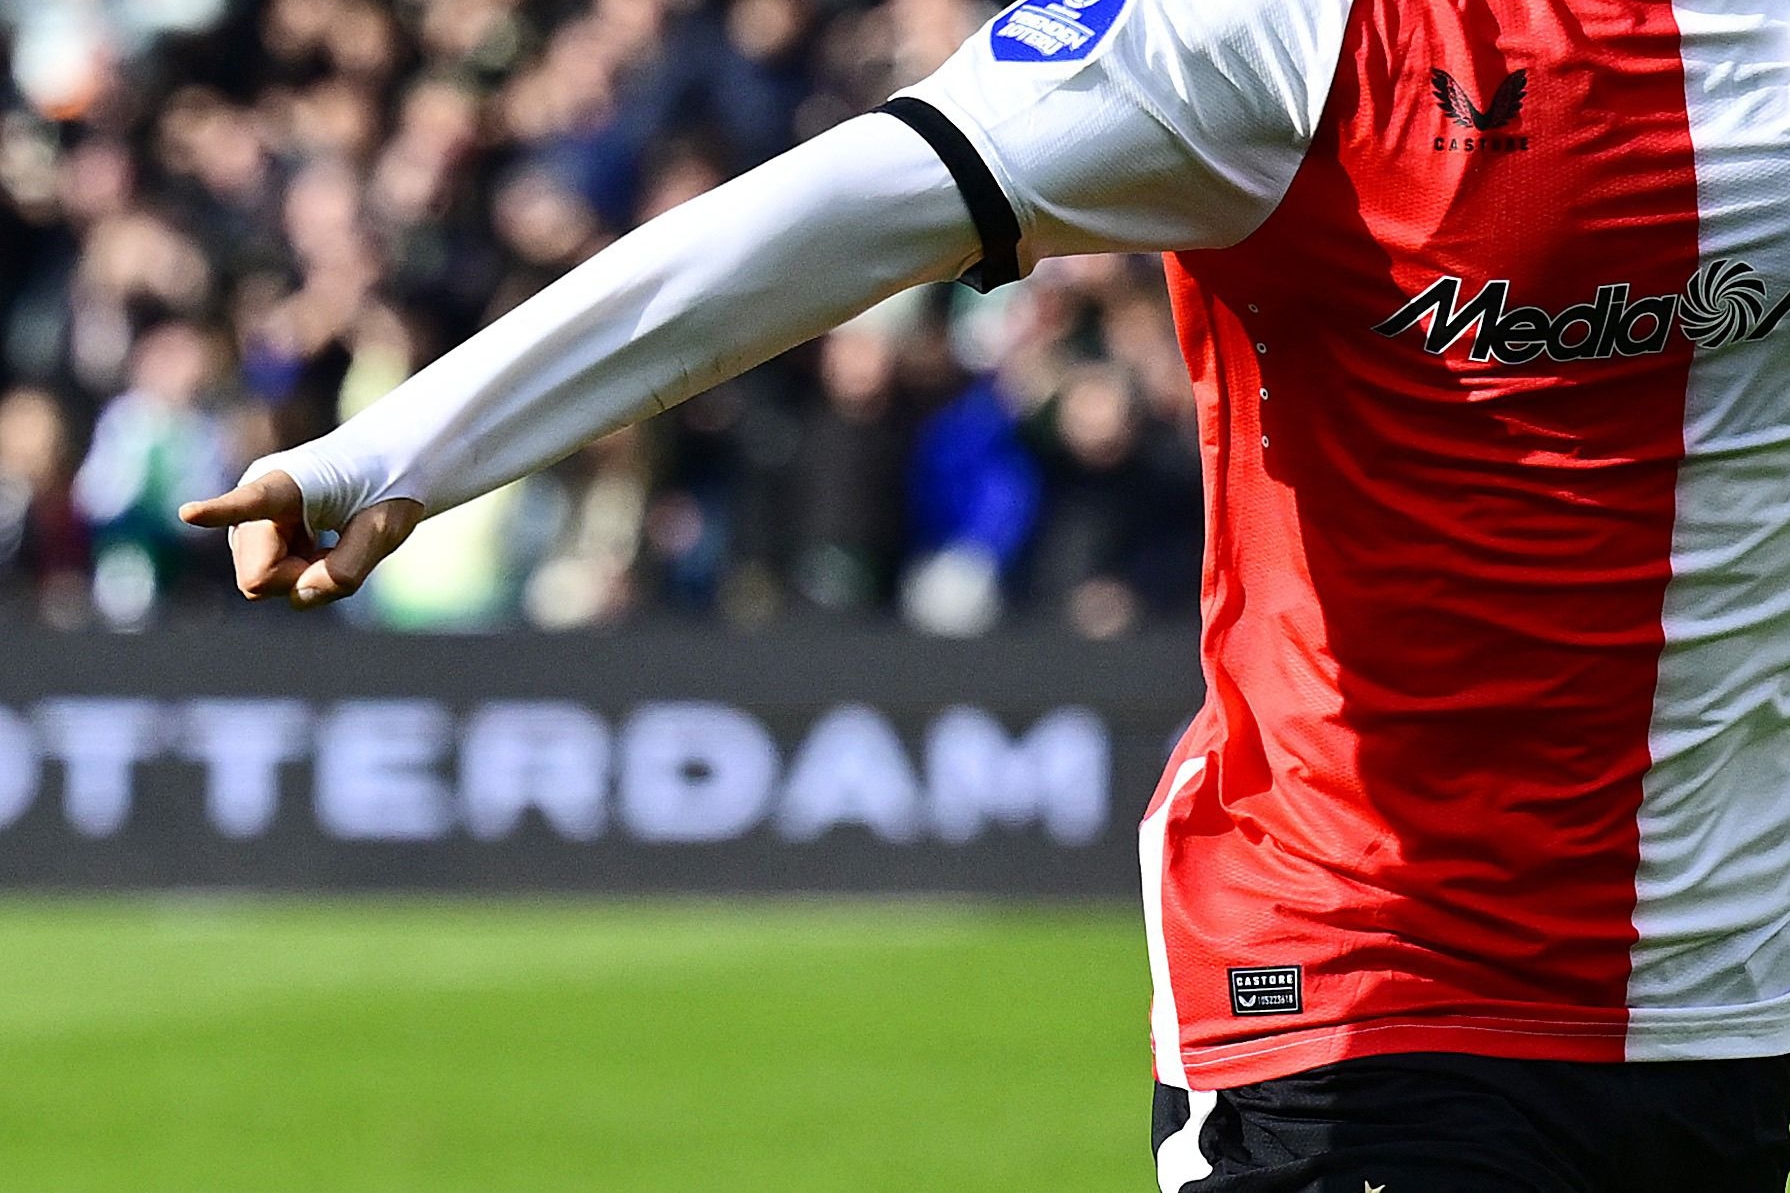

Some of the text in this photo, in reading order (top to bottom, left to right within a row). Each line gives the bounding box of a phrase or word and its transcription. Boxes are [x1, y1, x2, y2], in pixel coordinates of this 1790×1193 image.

[1433, 137, 1529, 152] CASTORE
[1370, 275, 1678, 364] Media
[0, 698, 1112, 846] TTERDAM
[1236, 975, 1293, 986] CASTORE
